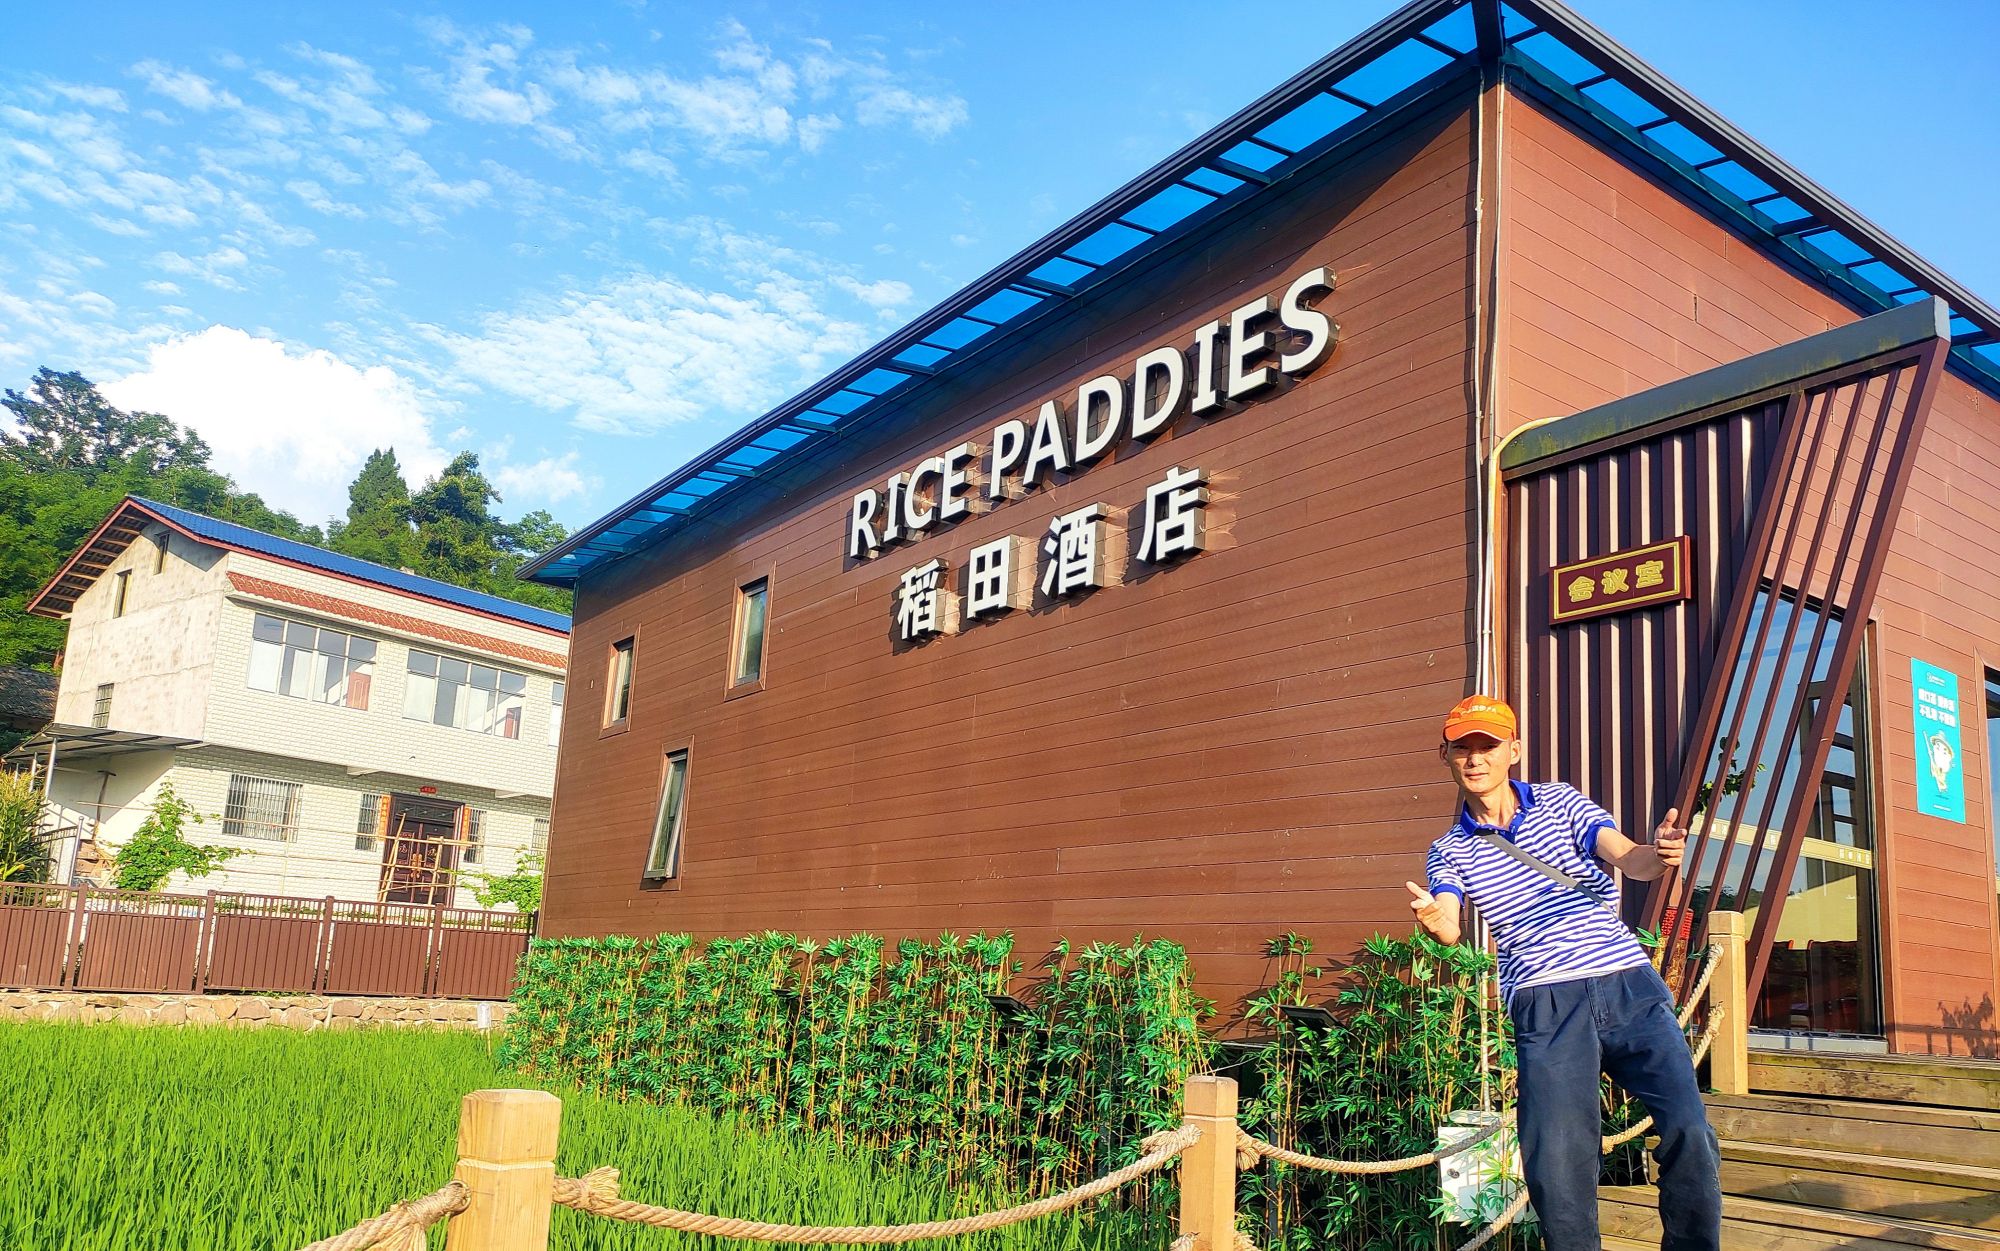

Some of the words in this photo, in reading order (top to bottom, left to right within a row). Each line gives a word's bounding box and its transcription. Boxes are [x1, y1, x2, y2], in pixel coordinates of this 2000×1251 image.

[850, 441, 973, 559] RICE
[990, 266, 1339, 499] PADDIES
[897, 465, 1208, 640] 稻田酒店
[1568, 560, 1664, 603] 会议室
